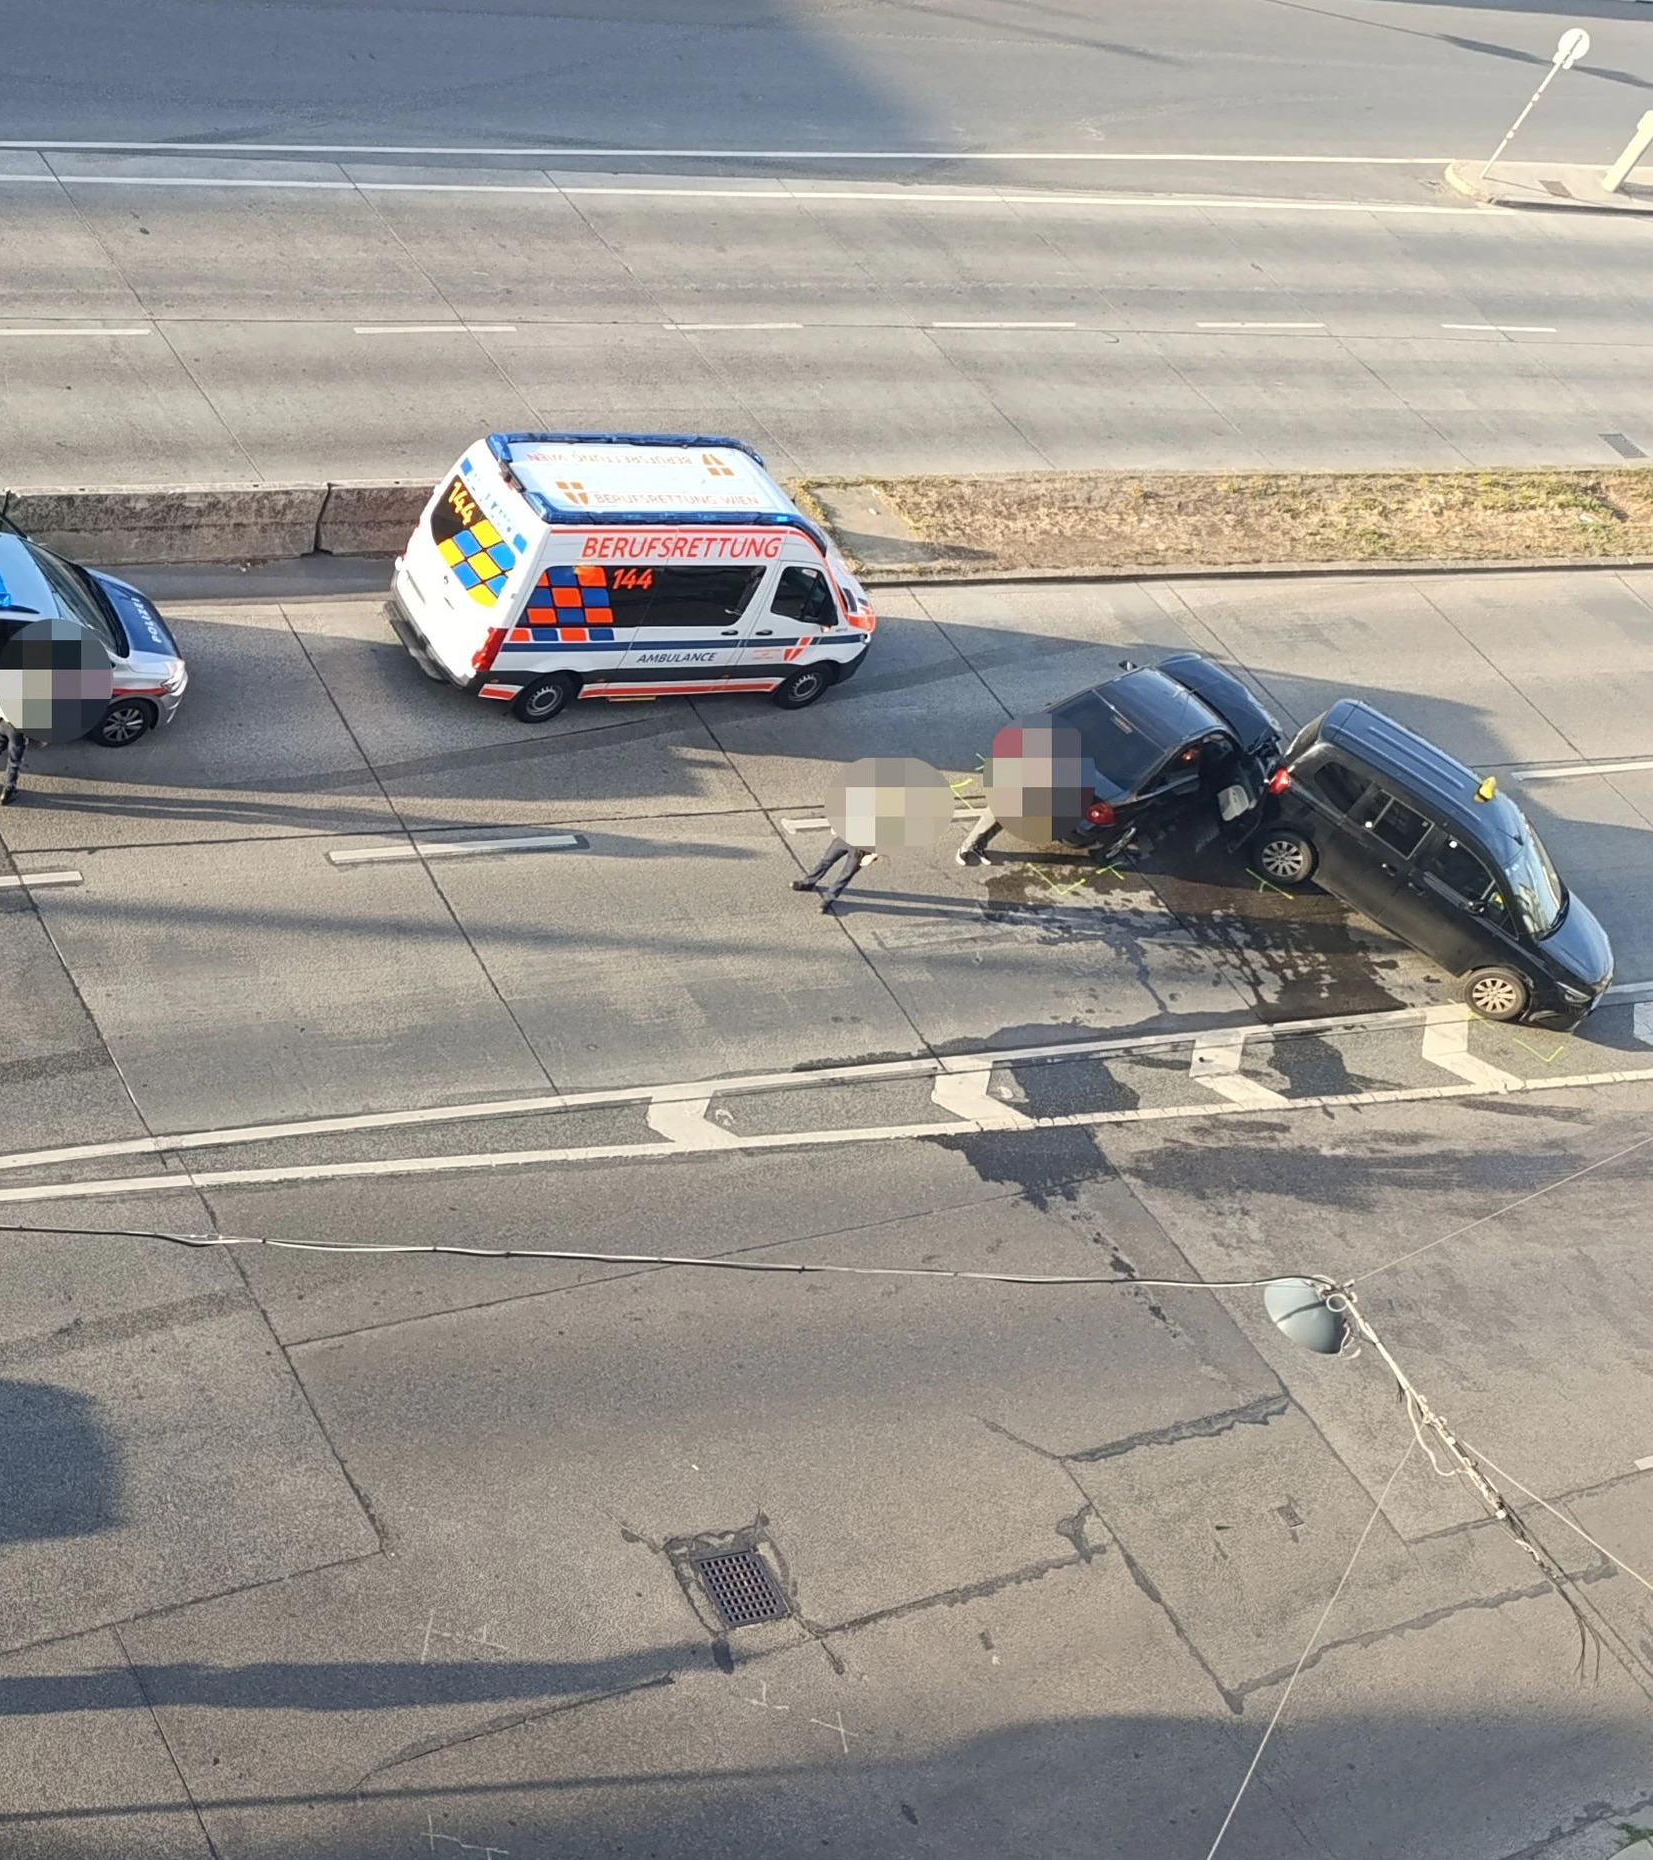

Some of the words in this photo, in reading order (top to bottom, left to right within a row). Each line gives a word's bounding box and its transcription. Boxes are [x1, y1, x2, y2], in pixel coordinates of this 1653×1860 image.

[448, 481, 476, 526] 144
[594, 492, 718, 505] BERUFSRETTUNG
[721, 494, 761, 505] WIEN
[581, 537, 782, 558] BERUFSRETTUNG
[612, 568, 653, 590] 144
[130, 597, 162, 643] POLIZEI
[635, 652, 718, 664] AMBULANCE
